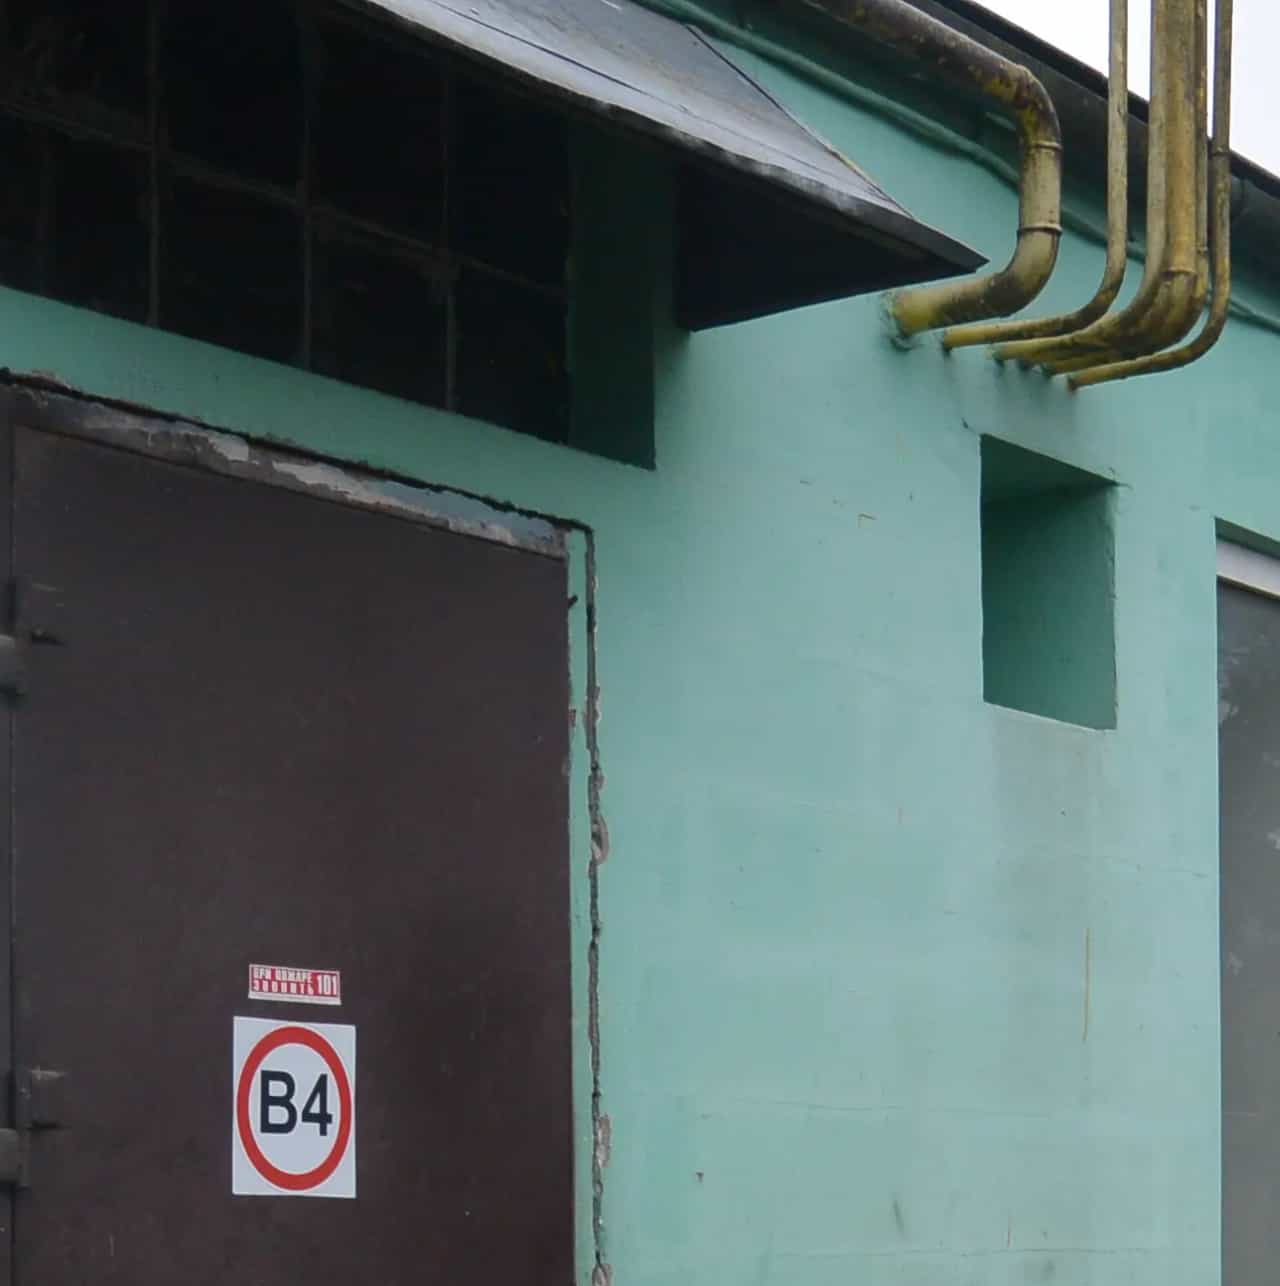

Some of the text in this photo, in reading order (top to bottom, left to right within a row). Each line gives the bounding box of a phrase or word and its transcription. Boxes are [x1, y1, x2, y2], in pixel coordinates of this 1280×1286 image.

[253, 974, 337, 995] ЗВОНИТЬ 101
[275, 968, 312, 984] ПОЖАРЕ
